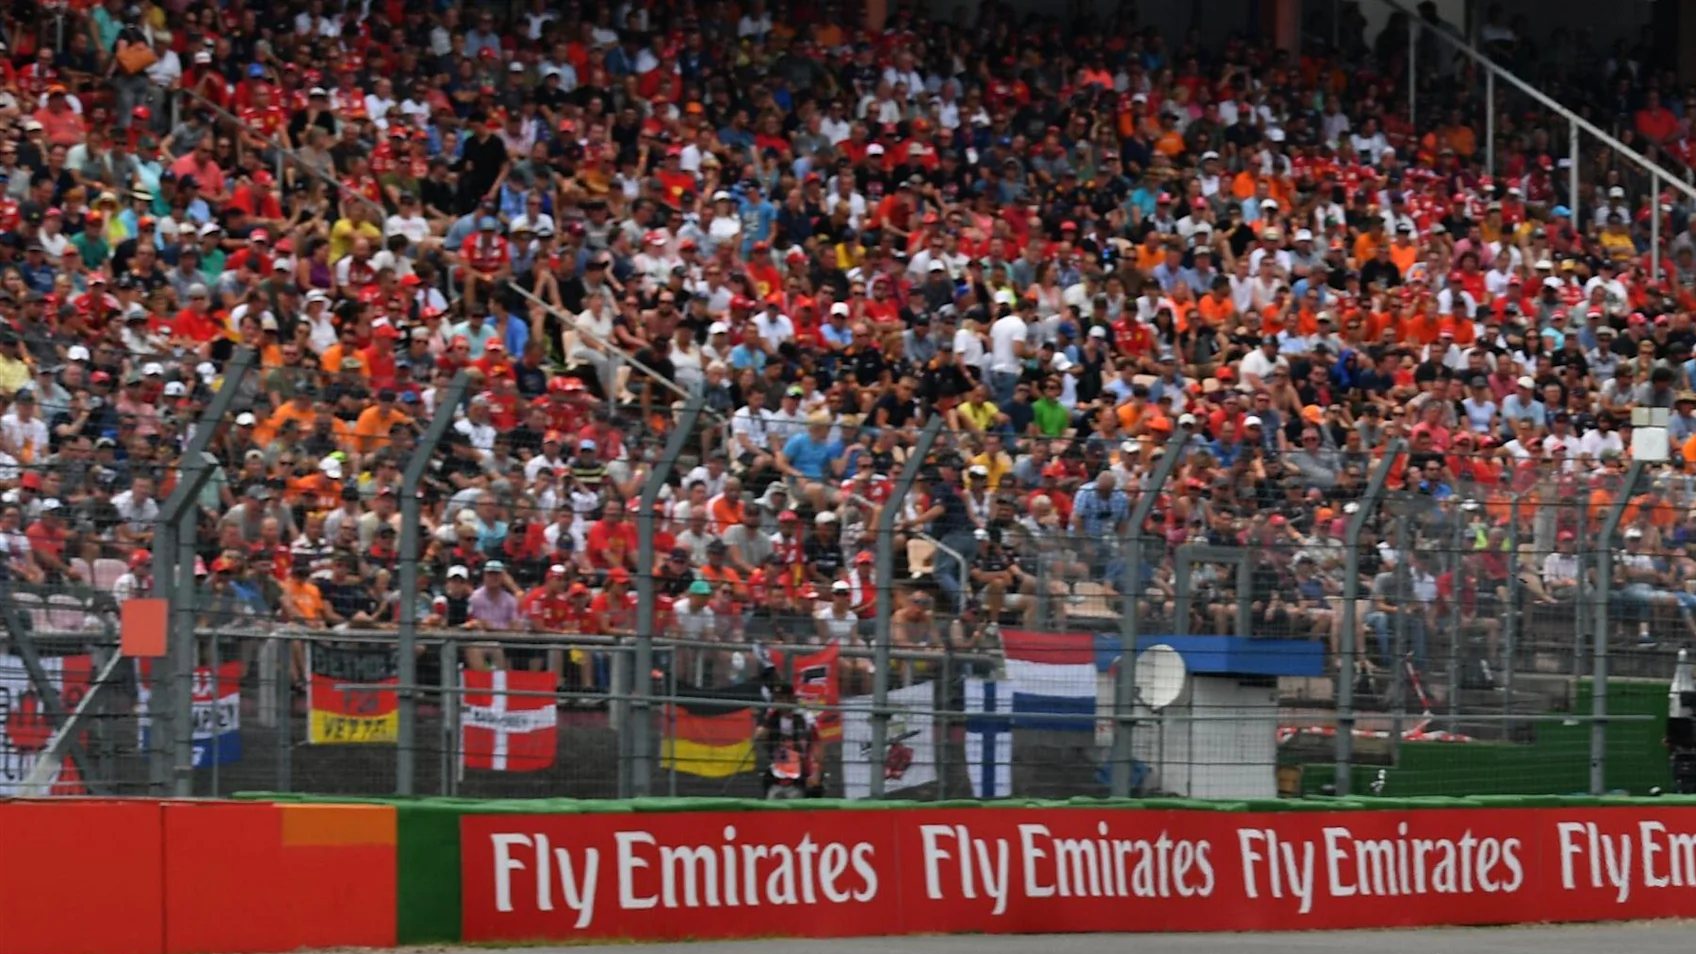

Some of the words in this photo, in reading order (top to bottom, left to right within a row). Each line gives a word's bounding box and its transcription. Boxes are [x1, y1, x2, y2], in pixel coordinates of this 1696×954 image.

[490, 833, 599, 929] Fly
[614, 825, 878, 909] Emirates
[920, 824, 1009, 915] Fly
[1018, 821, 1215, 897] Emirates
[1237, 828, 1315, 914] Fly
[1322, 822, 1523, 897] Emirates
[1557, 822, 1632, 903] Fly
